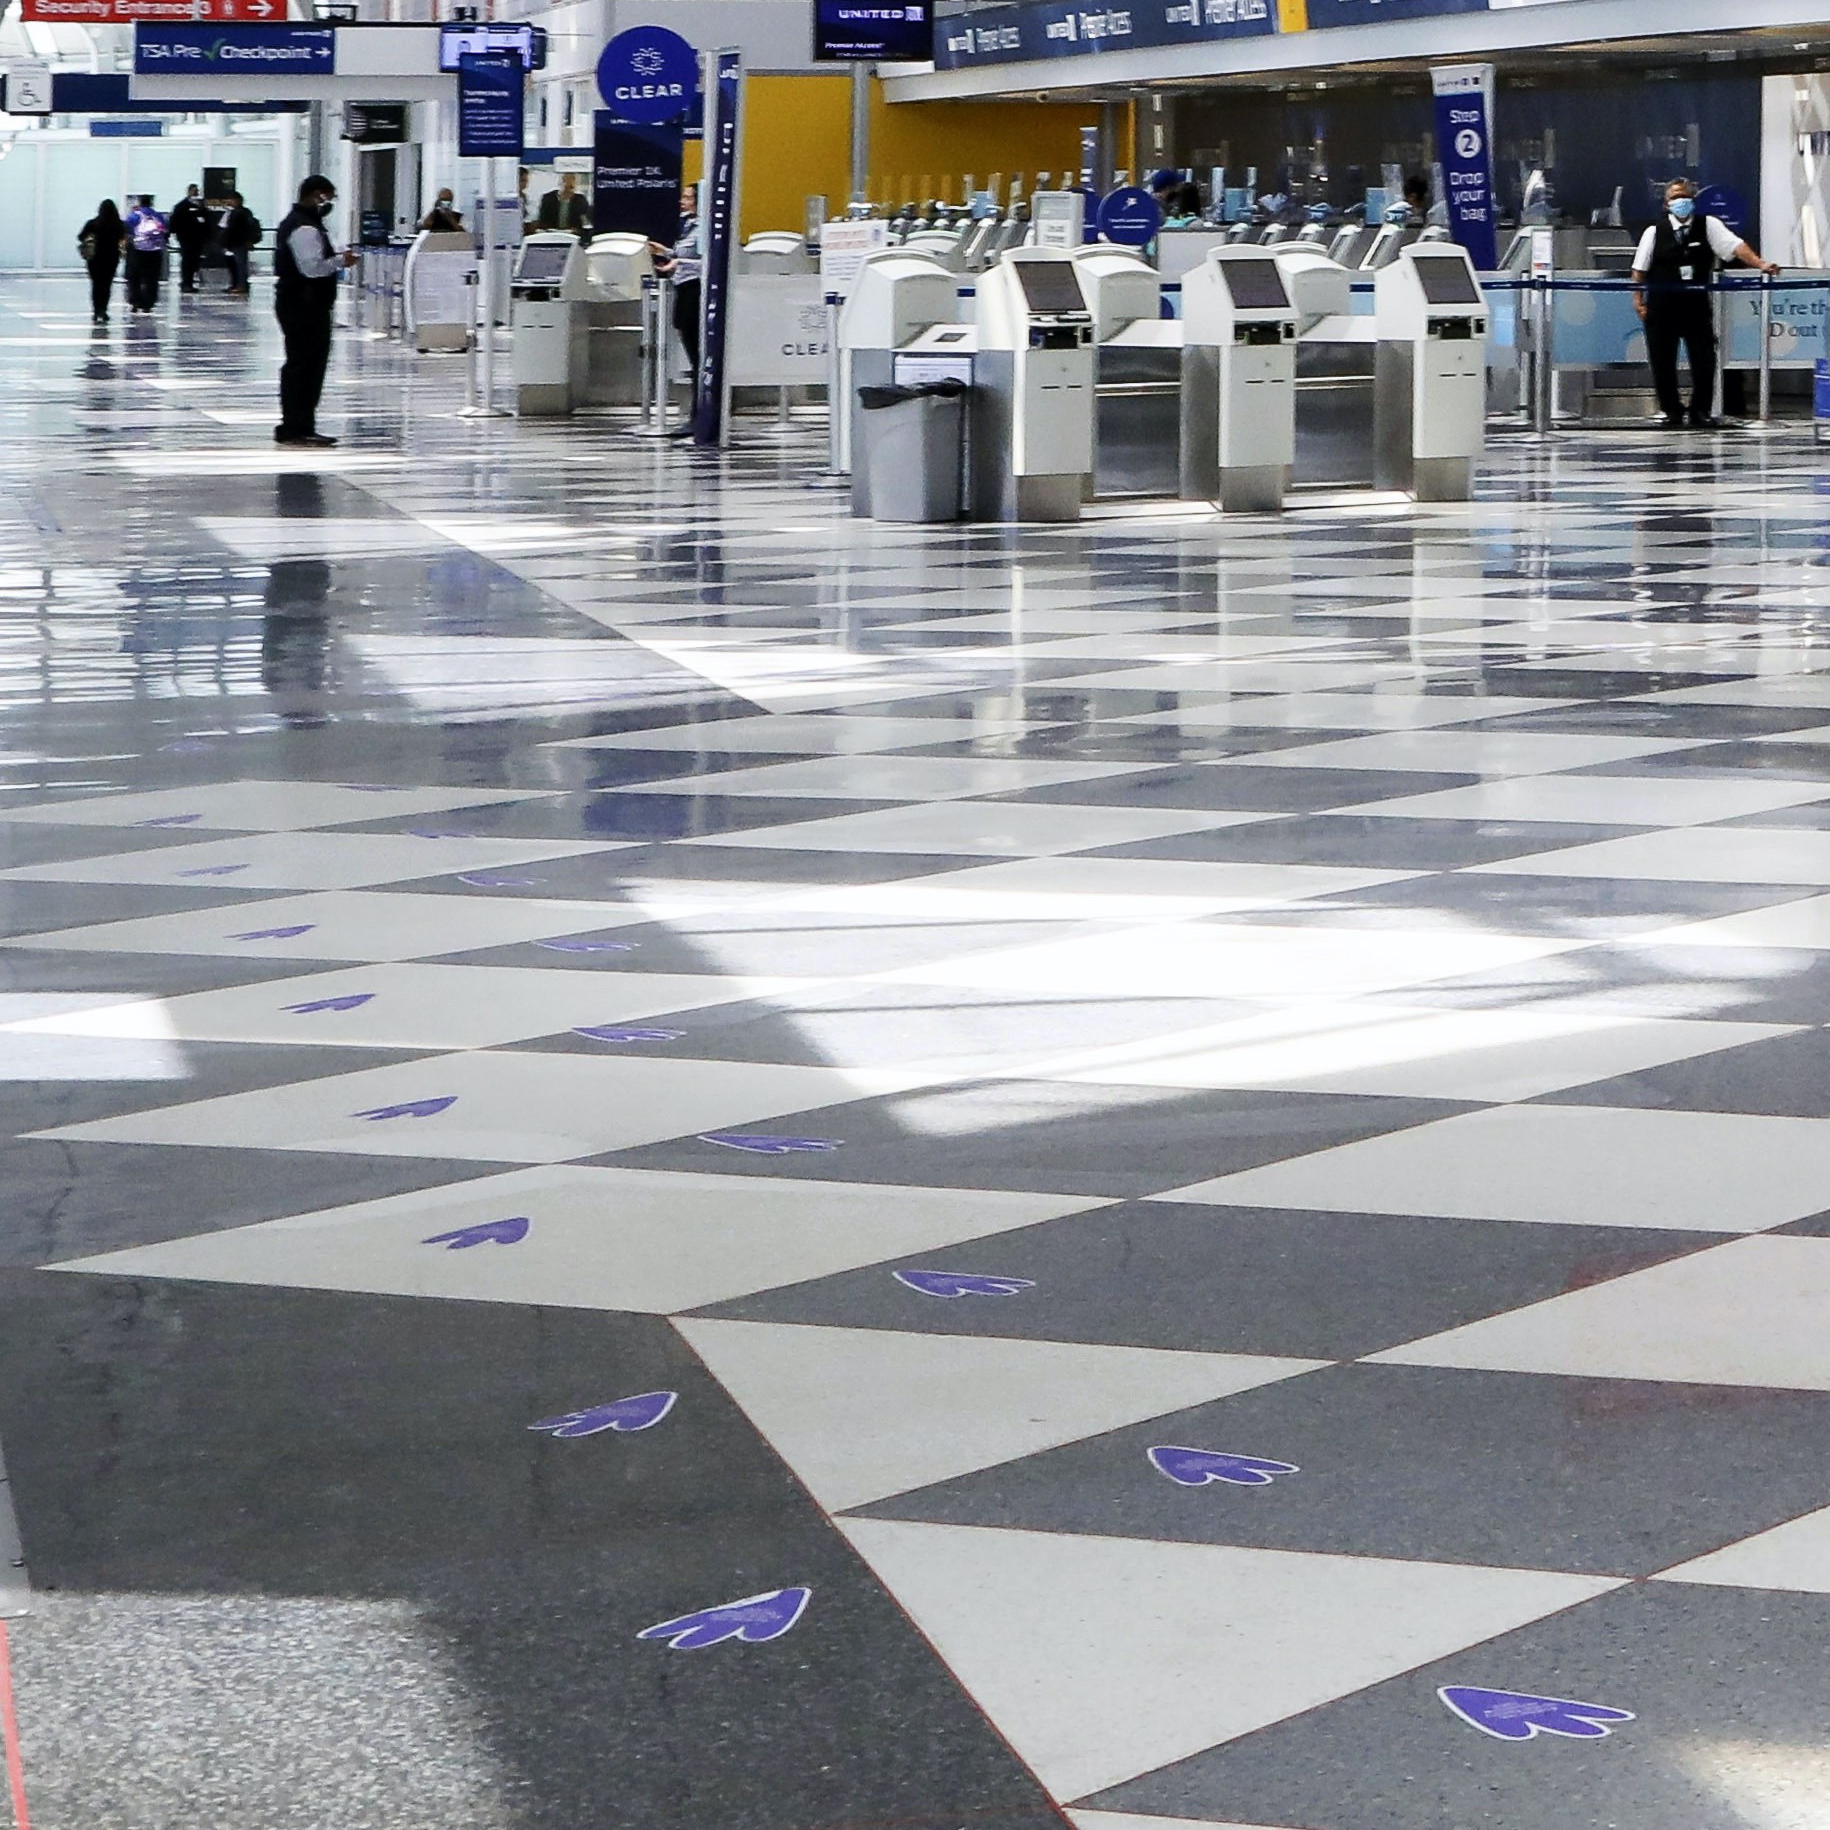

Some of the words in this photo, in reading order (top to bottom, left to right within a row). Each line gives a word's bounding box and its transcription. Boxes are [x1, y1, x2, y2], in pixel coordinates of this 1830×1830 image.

[35, 0, 110, 17] Security
[115, 0, 195, 15] Entrance
[200, 1, 211, 15] 3
[838, 9, 904, 19] UNITED
[140, 43, 173, 58] TSA
[174, 44, 202, 58] Pre
[220, 44, 312, 61] Checkpoint
[615, 83, 683, 100] CLEAR
[1450, 109, 1480, 124] Step
[1462, 133, 1475, 153] 2
[1450, 172, 1485, 186] Drop
[1452, 189, 1485, 205] your
[1461, 207, 1488, 221] bag
[1750, 297, 1809, 316] Yu're
[781, 343, 828, 357] CLEA
